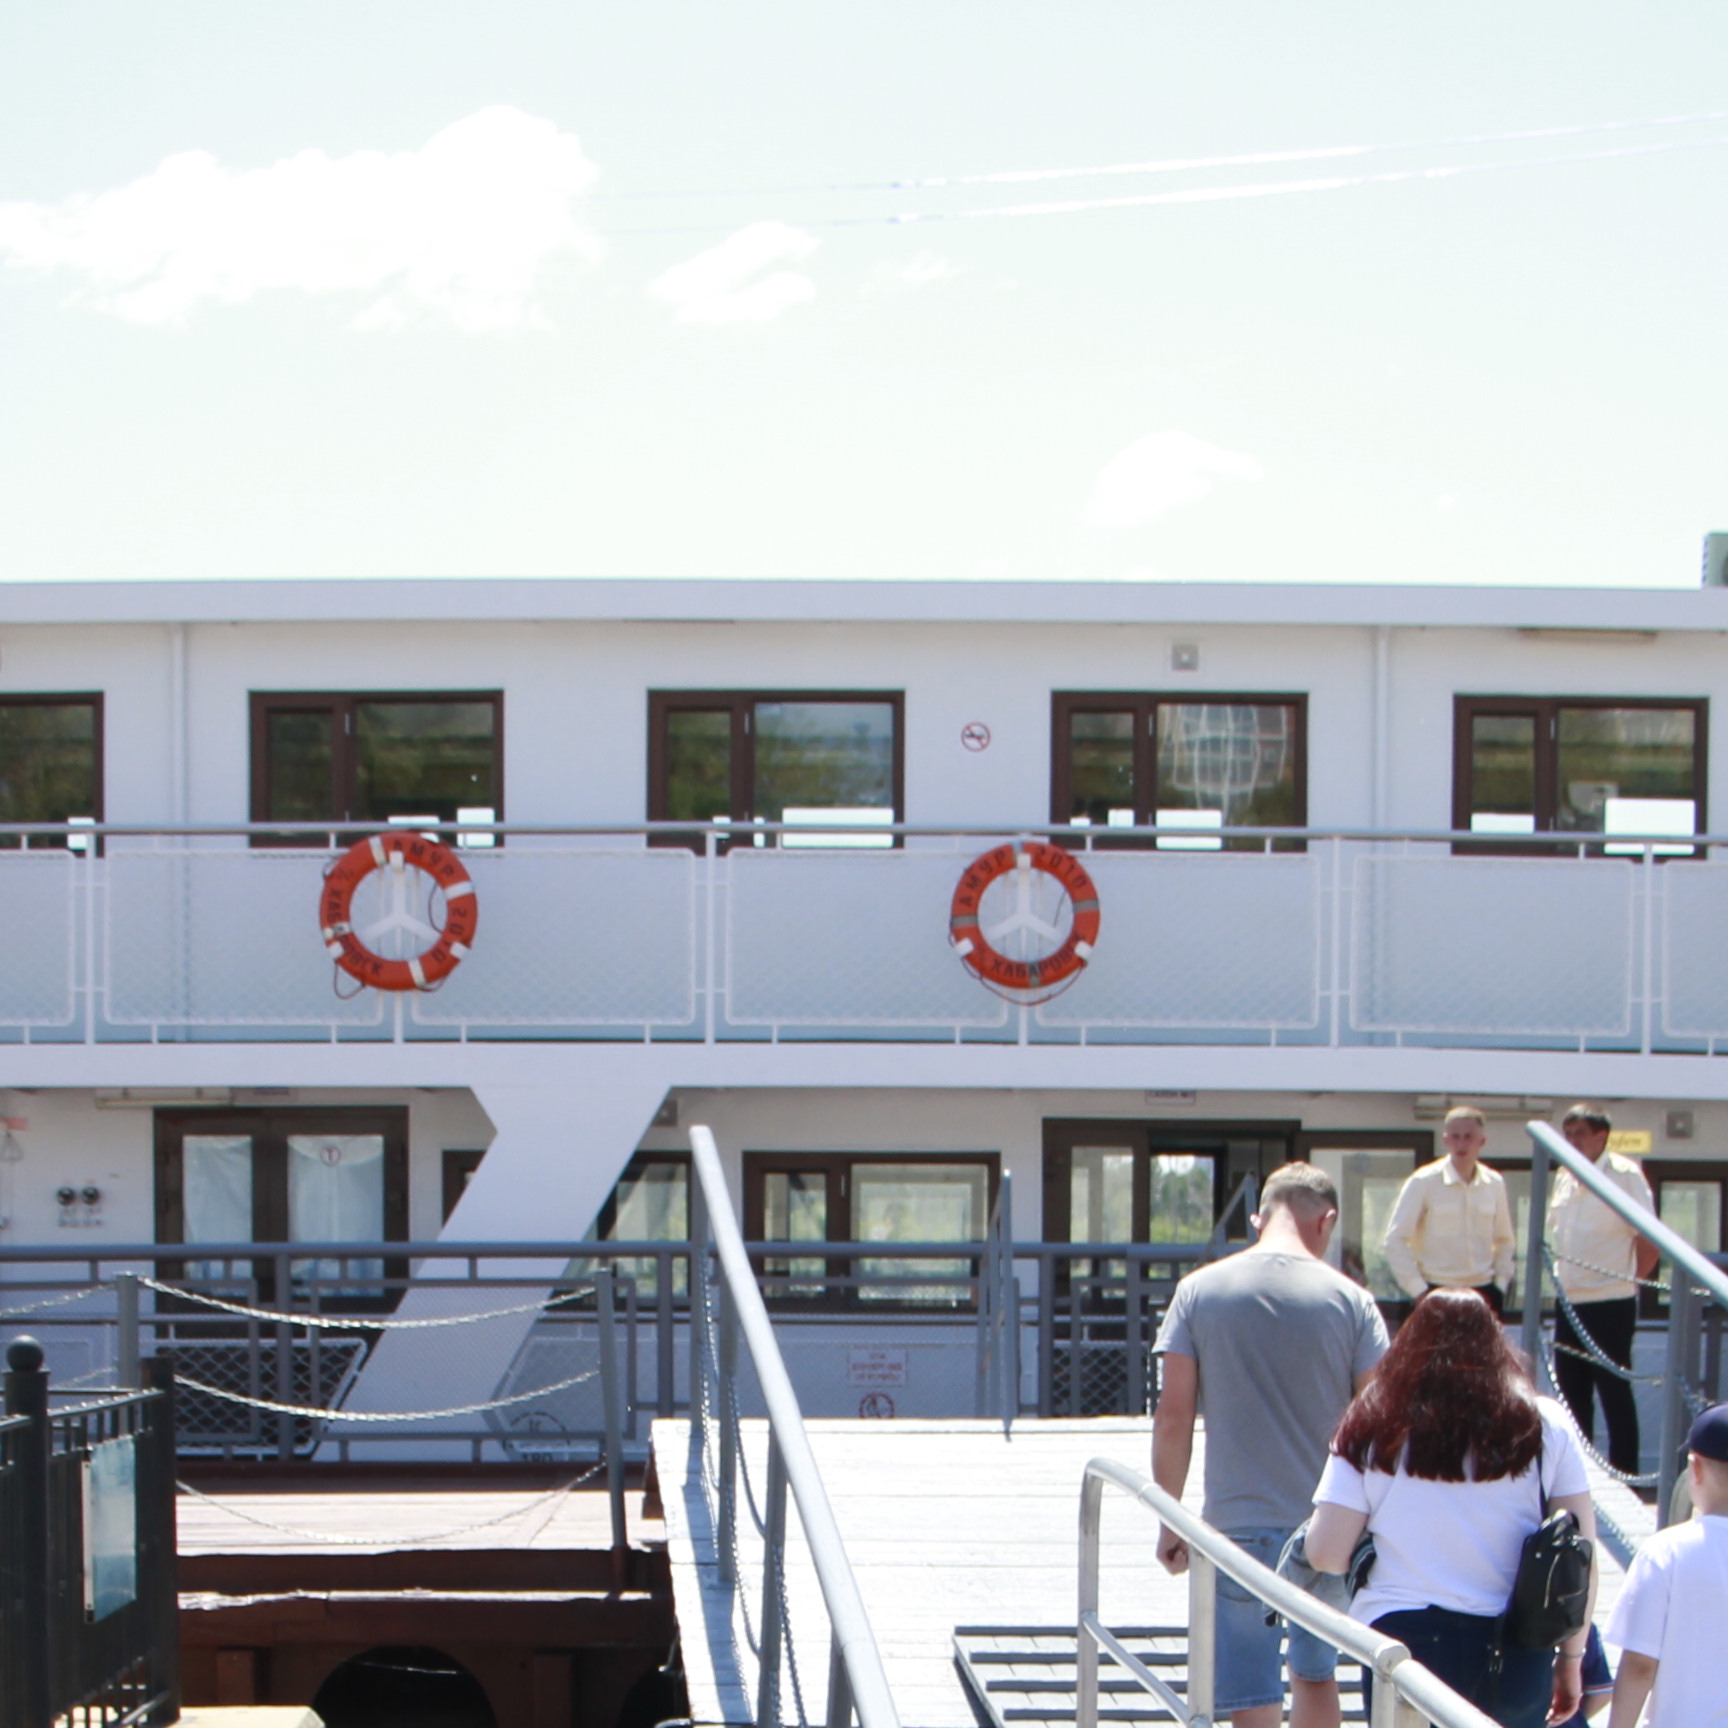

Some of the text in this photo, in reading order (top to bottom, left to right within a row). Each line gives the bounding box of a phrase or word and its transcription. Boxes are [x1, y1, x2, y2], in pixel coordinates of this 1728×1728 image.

[392, 839, 456, 877] АМУР
[959, 849, 1007, 908] АМУР
[1035, 846, 1088, 890] 2010
